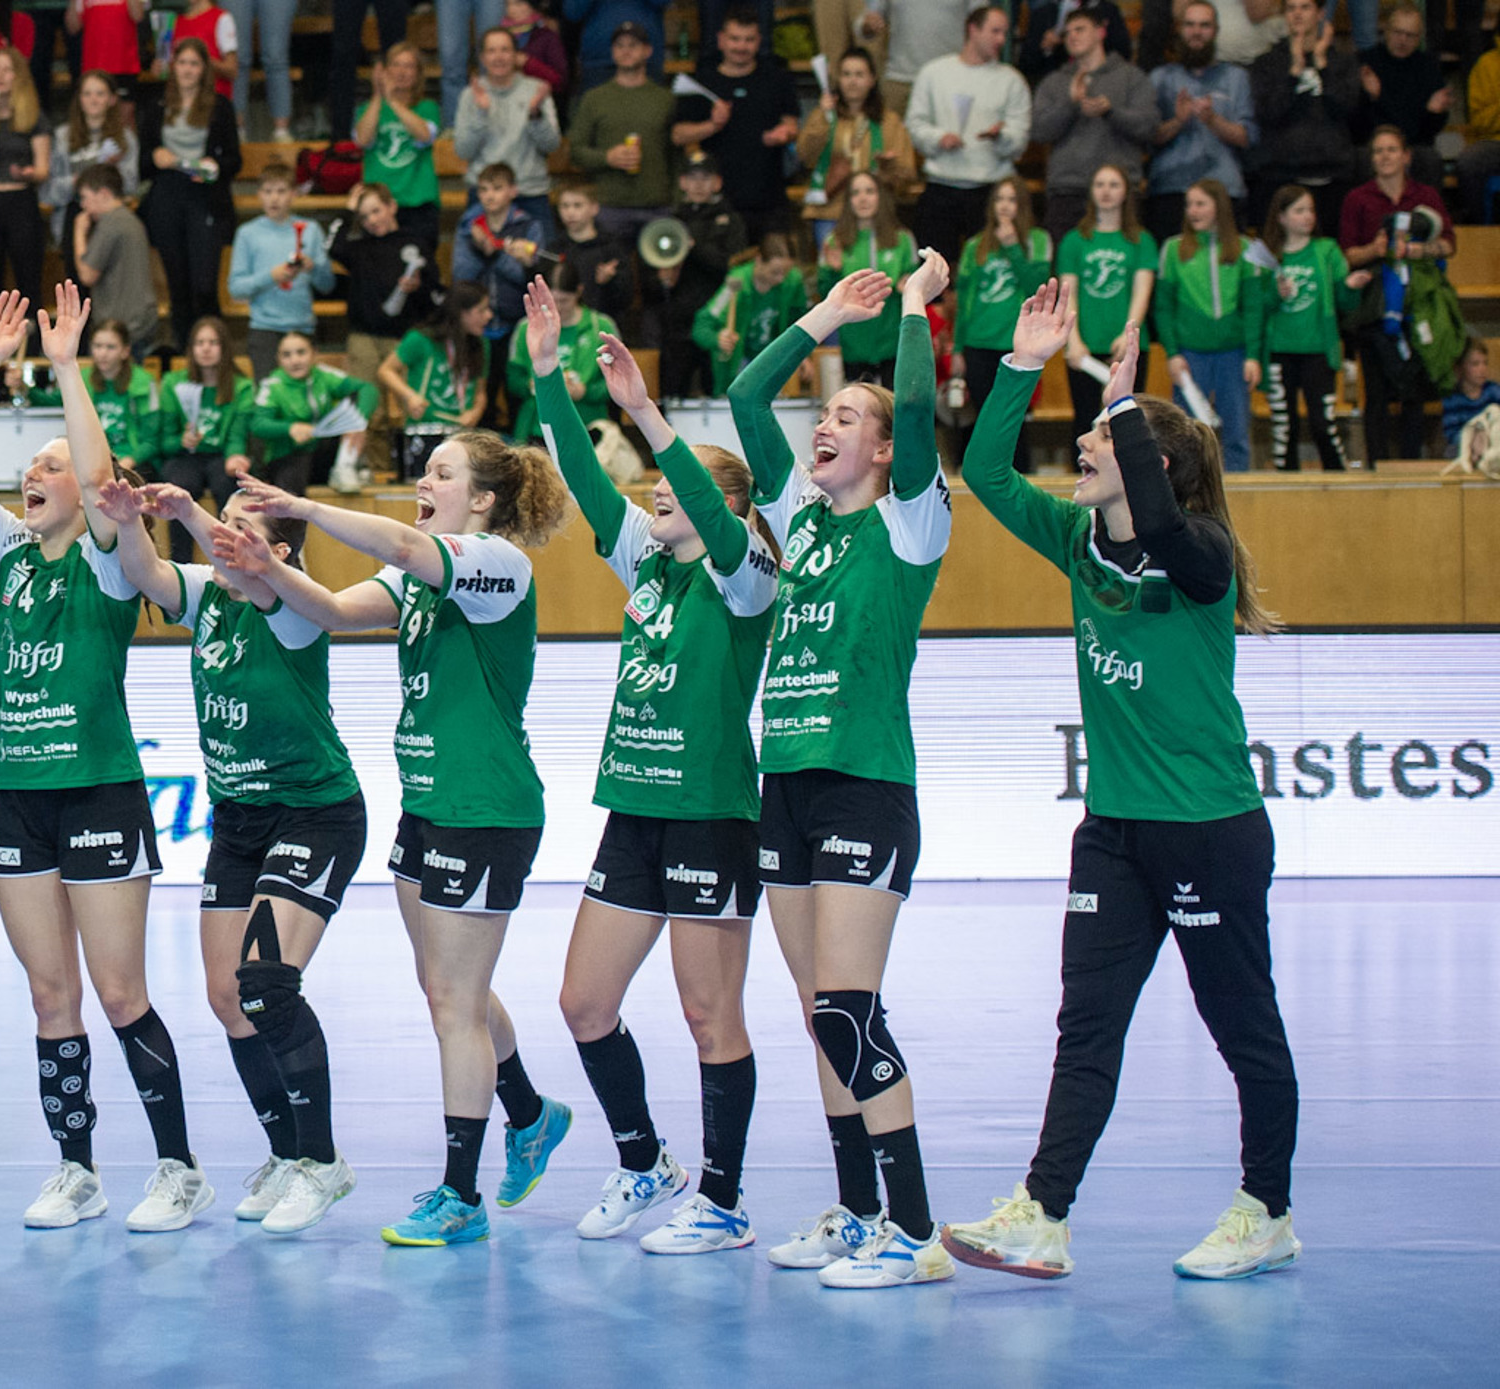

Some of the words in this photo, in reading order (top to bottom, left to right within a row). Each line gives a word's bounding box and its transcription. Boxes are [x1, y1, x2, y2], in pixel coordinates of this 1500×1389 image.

[17, 579, 35, 614] 4
[406, 609, 423, 647] 9
[5, 689, 40, 707] Wyss
